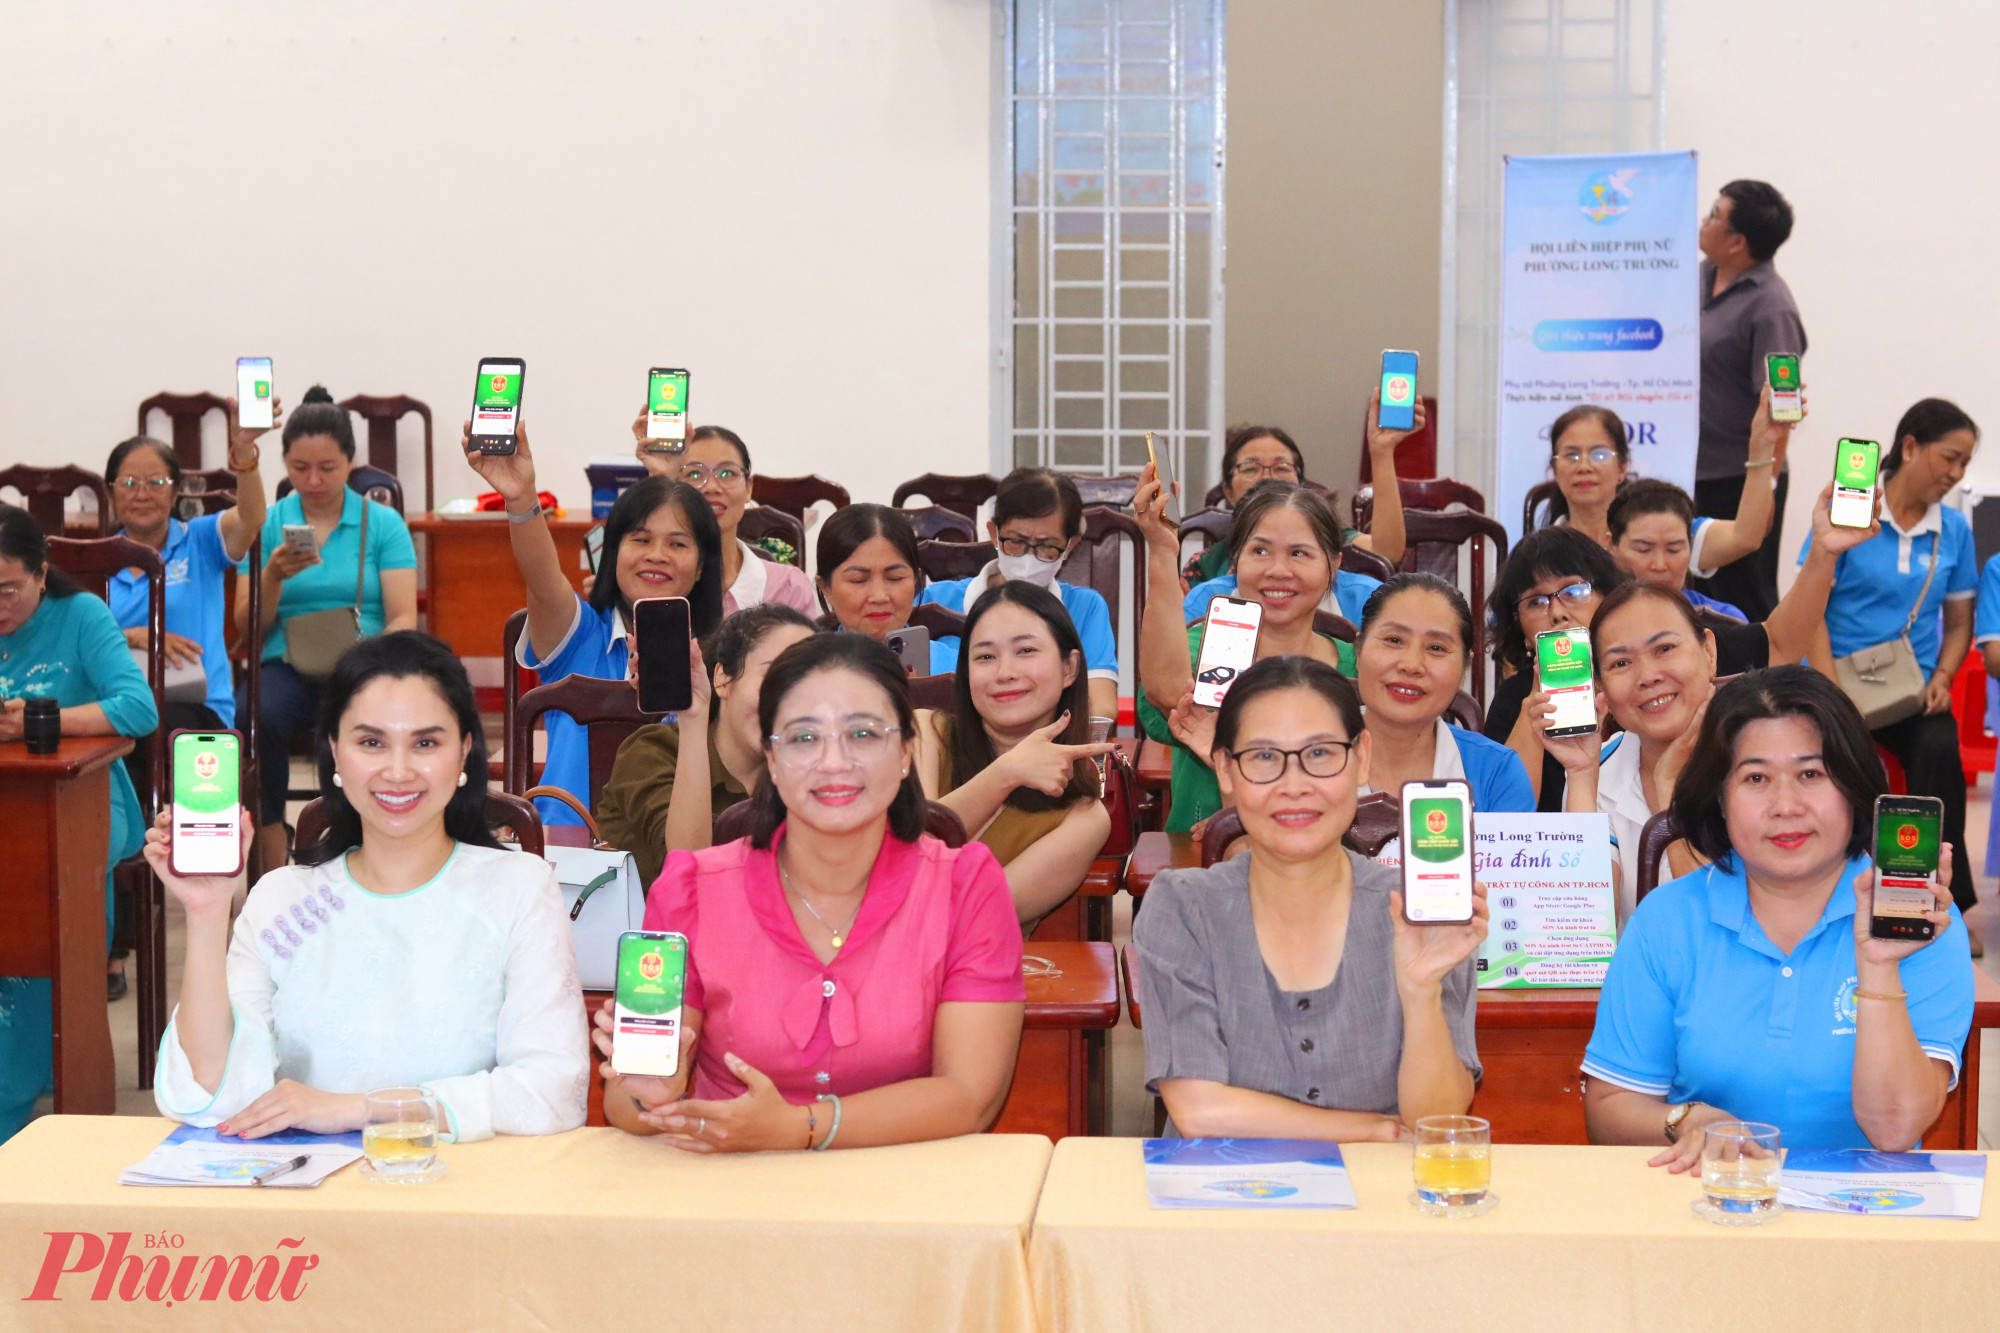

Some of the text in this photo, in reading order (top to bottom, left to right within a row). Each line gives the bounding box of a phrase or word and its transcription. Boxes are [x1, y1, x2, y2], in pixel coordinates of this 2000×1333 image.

[1583, 259, 1619, 271] LONG
[1614, 327, 1656, 346] facebook
[1500, 831, 1532, 843] Long
[1535, 831, 1584, 843] Trường
[1474, 849, 1584, 873] Gia đình Số
[1485, 880, 1511, 890] TRẬT
[1512, 880, 1526, 890] TỰ
[1527, 880, 1555, 888] CÔNG
[1502, 898, 1514, 907] 01
[1504, 921, 1516, 930] 02
[1505, 942, 1518, 952] 03
[1505, 967, 1518, 976] 04
